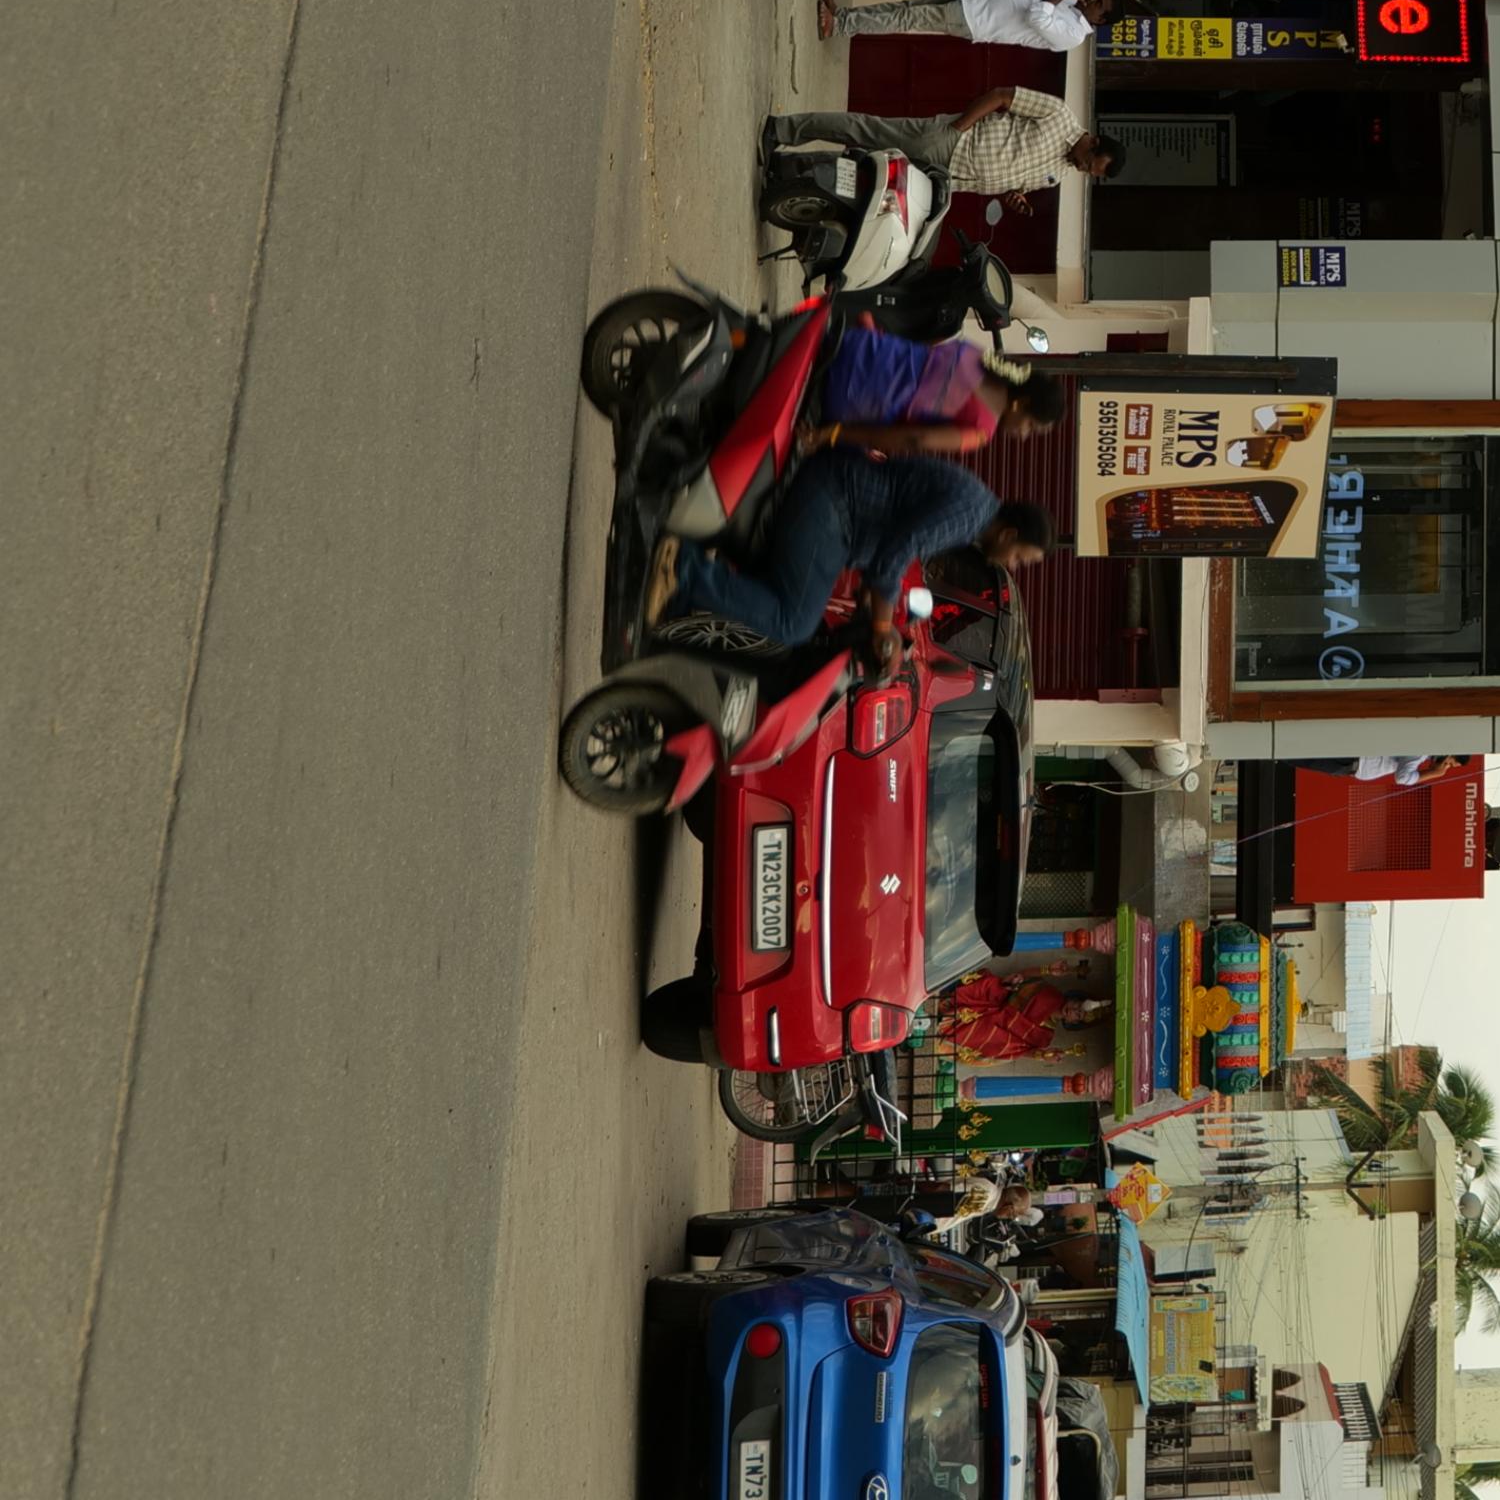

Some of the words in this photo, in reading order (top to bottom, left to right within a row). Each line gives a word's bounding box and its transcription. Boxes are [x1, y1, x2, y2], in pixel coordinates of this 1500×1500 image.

[1325, 252, 1341, 283] MPS
[1128, 408, 1138, 435] Available
[1139, 406, 1149, 415] AC
[1163, 409, 1176, 434] ROYAL
[1097, 401, 1118, 477] 9361305084
[1138, 416, 1149, 436] Rooms
[1176, 410, 1220, 468] MPS
[1127, 453, 1137, 469] FREE
[1137, 447, 1147, 474] Breakfast
[1161, 436, 1175, 466] PALACE
[889, 758, 897, 802] SWIFT
[1464, 782, 1478, 868] Mahindra
[762, 840, 782, 946] TN23CK2007
